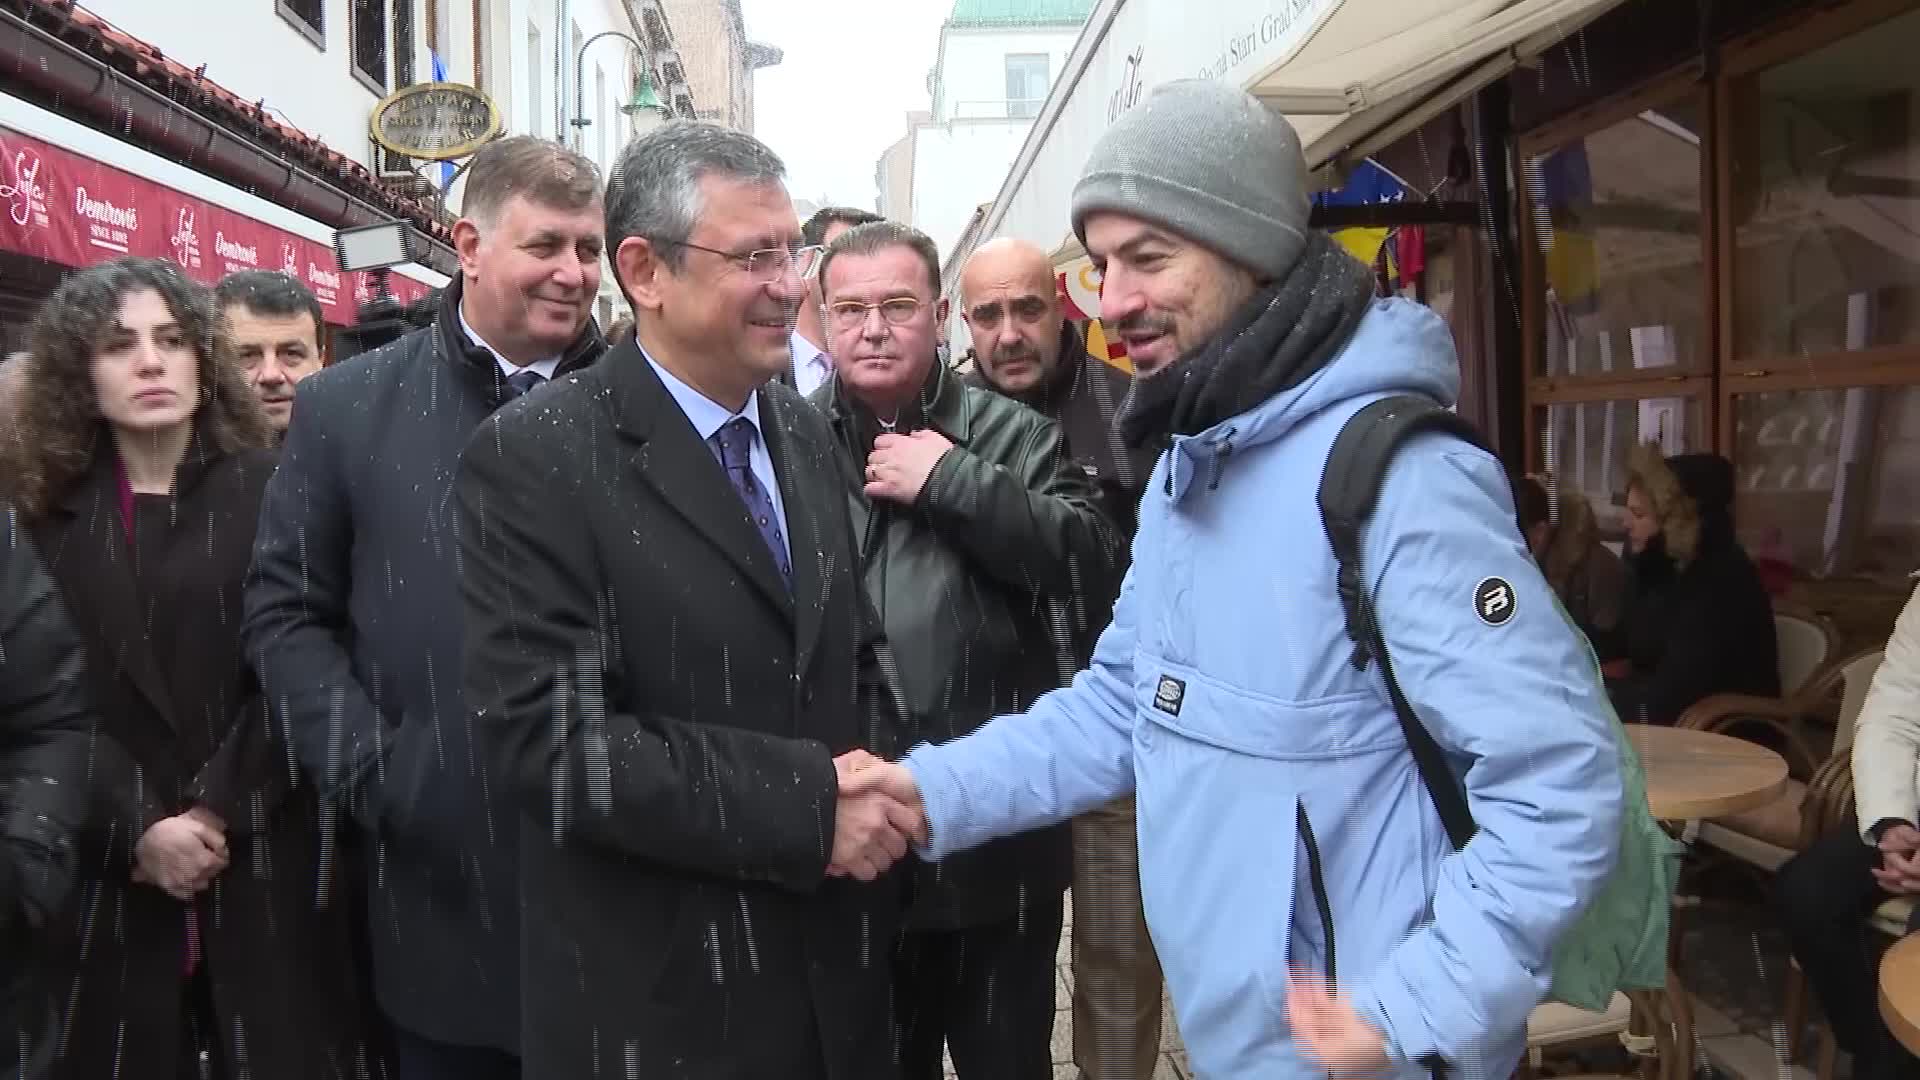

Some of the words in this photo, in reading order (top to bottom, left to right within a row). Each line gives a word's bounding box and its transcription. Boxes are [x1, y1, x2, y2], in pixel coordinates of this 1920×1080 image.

[1230, 23, 1257, 67] Stari
[1261, 0, 1292, 44] Grad
[76, 186, 138, 231] Demirović
